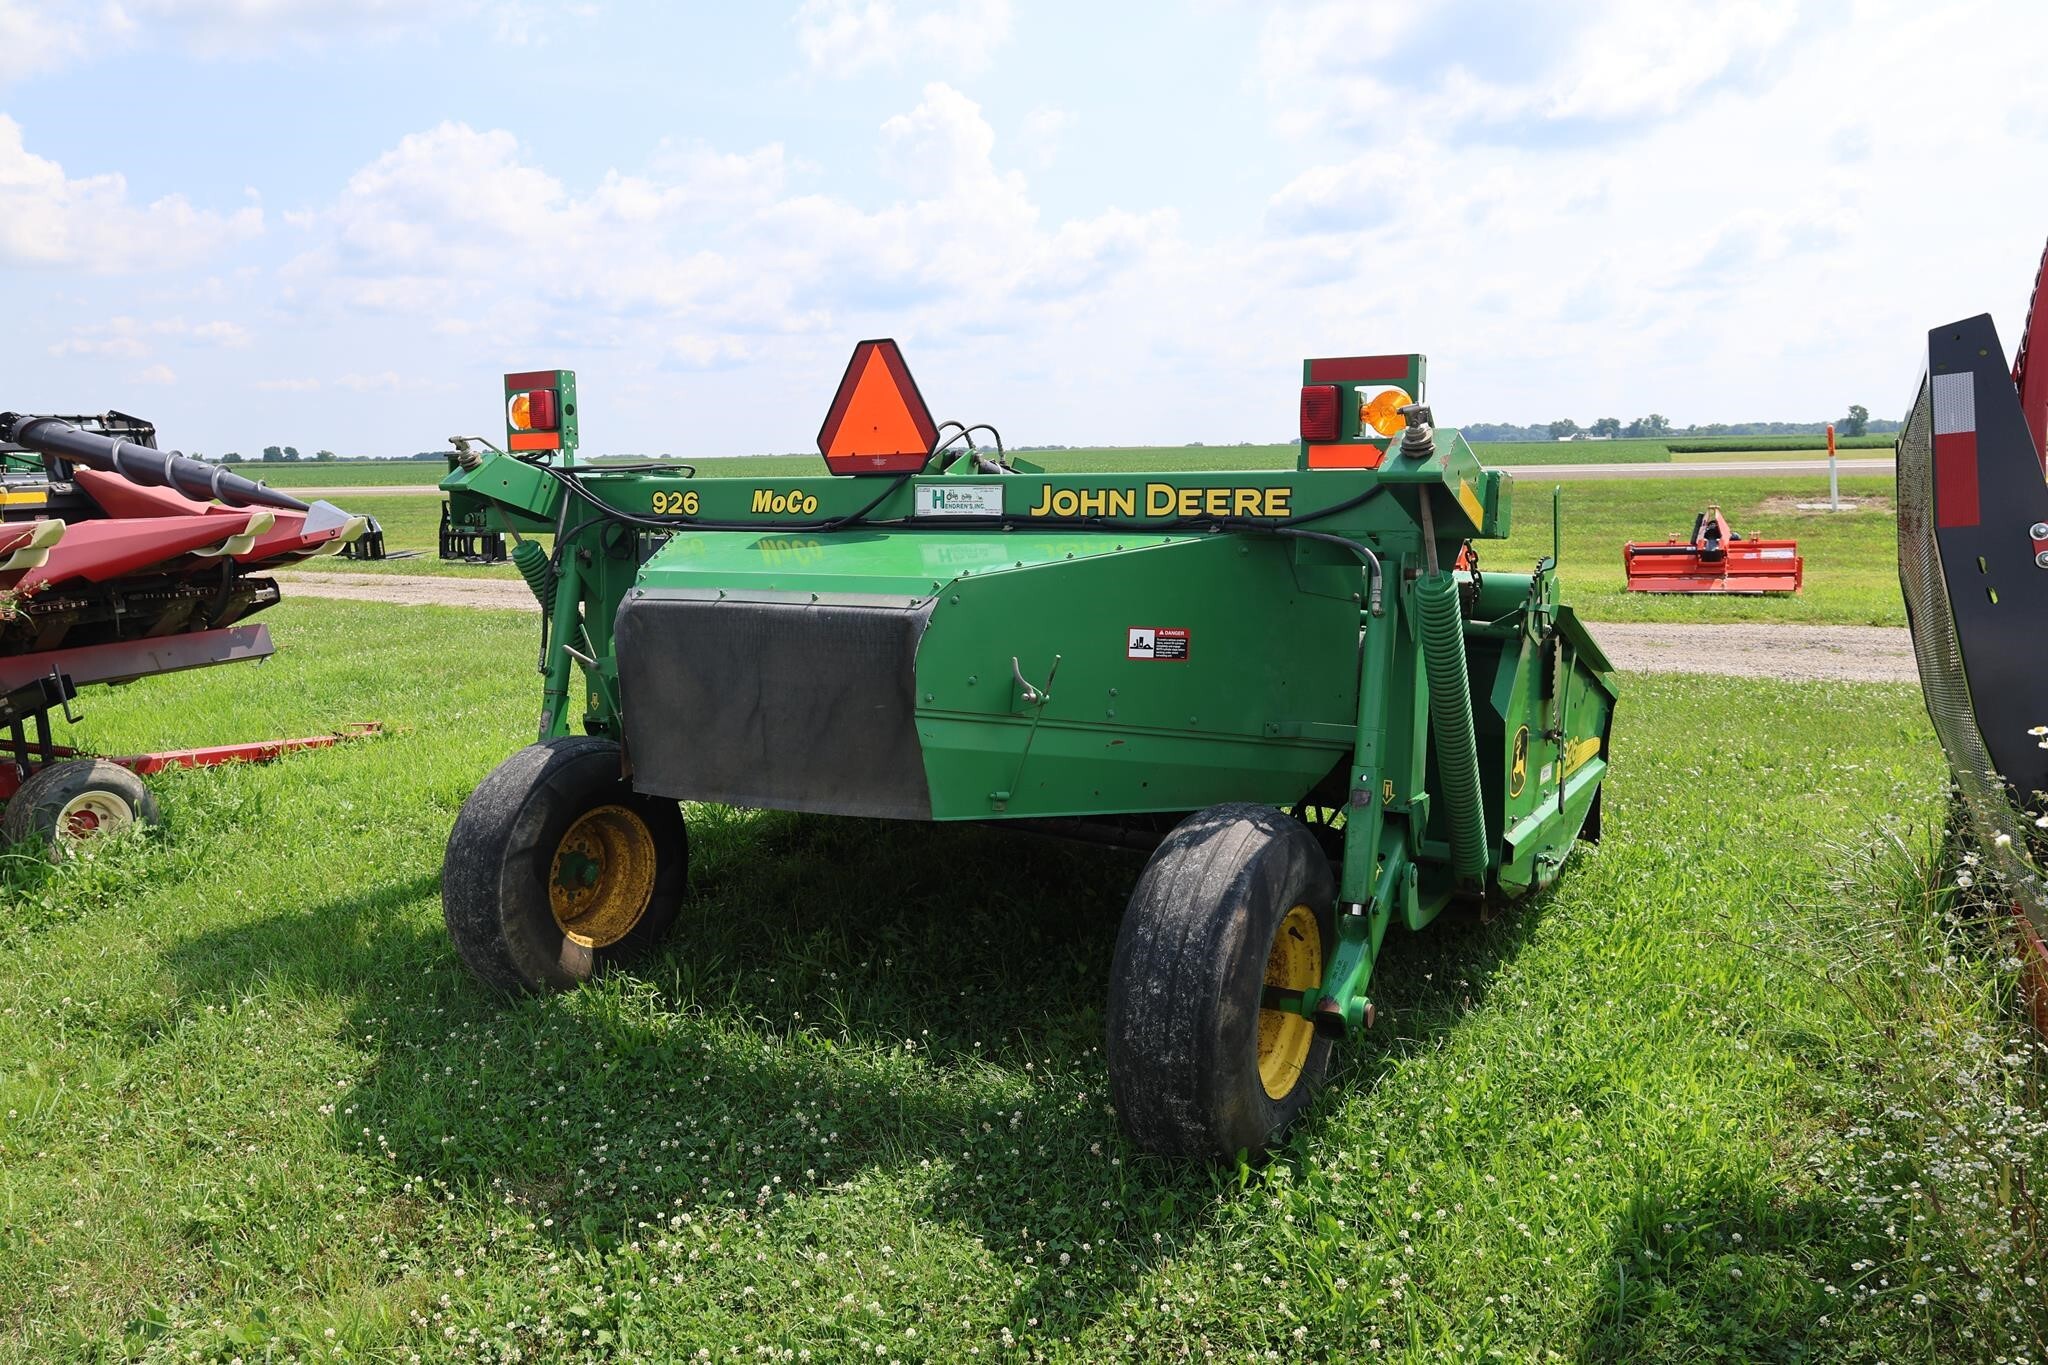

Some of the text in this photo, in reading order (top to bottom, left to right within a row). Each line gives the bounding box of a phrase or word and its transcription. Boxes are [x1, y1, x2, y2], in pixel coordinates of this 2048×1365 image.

[652, 491, 699, 515] 926
[752, 489, 819, 515] MoCo
[1030, 482, 1292, 518] JOHN DEERE
